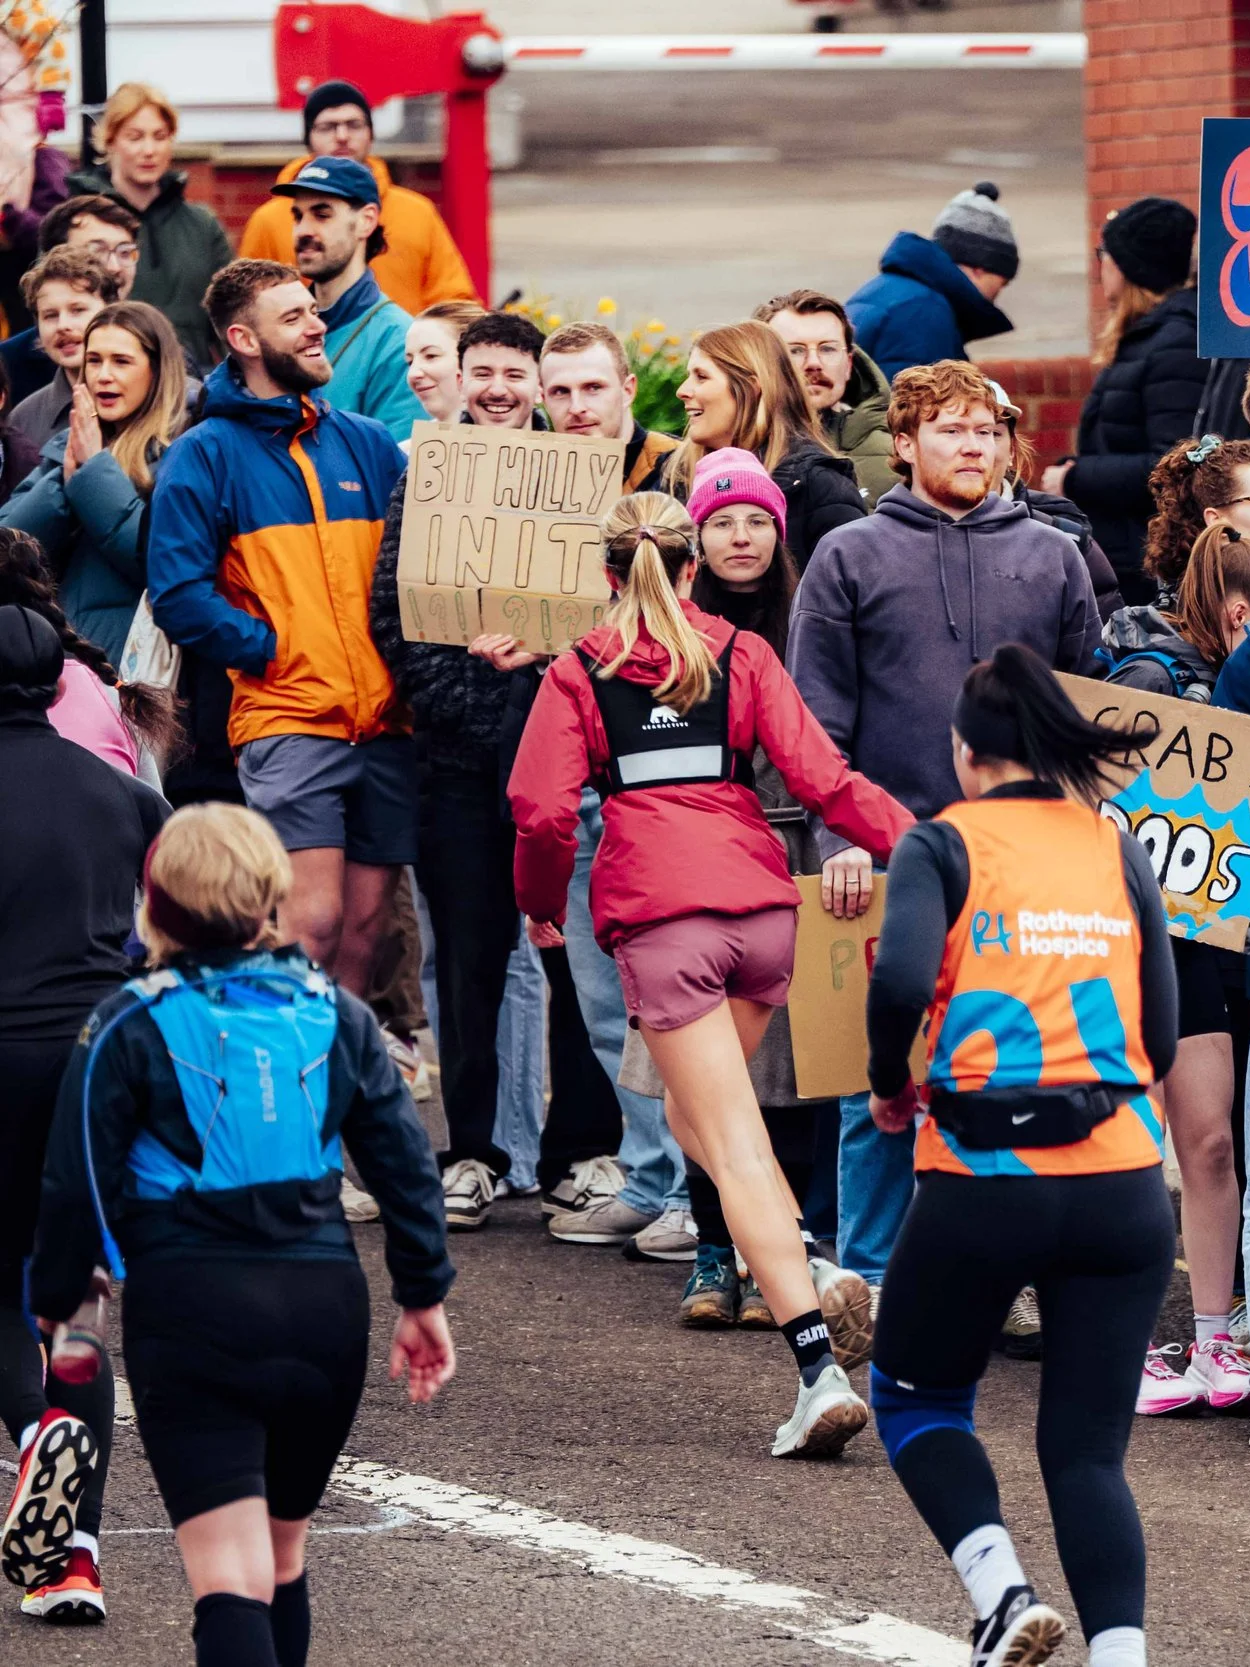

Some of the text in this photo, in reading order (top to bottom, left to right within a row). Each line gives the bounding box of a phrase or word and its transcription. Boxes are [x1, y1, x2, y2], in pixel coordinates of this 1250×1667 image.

[414, 439, 619, 515] BIT HILLY
[1019, 930, 1110, 960] Hospice
